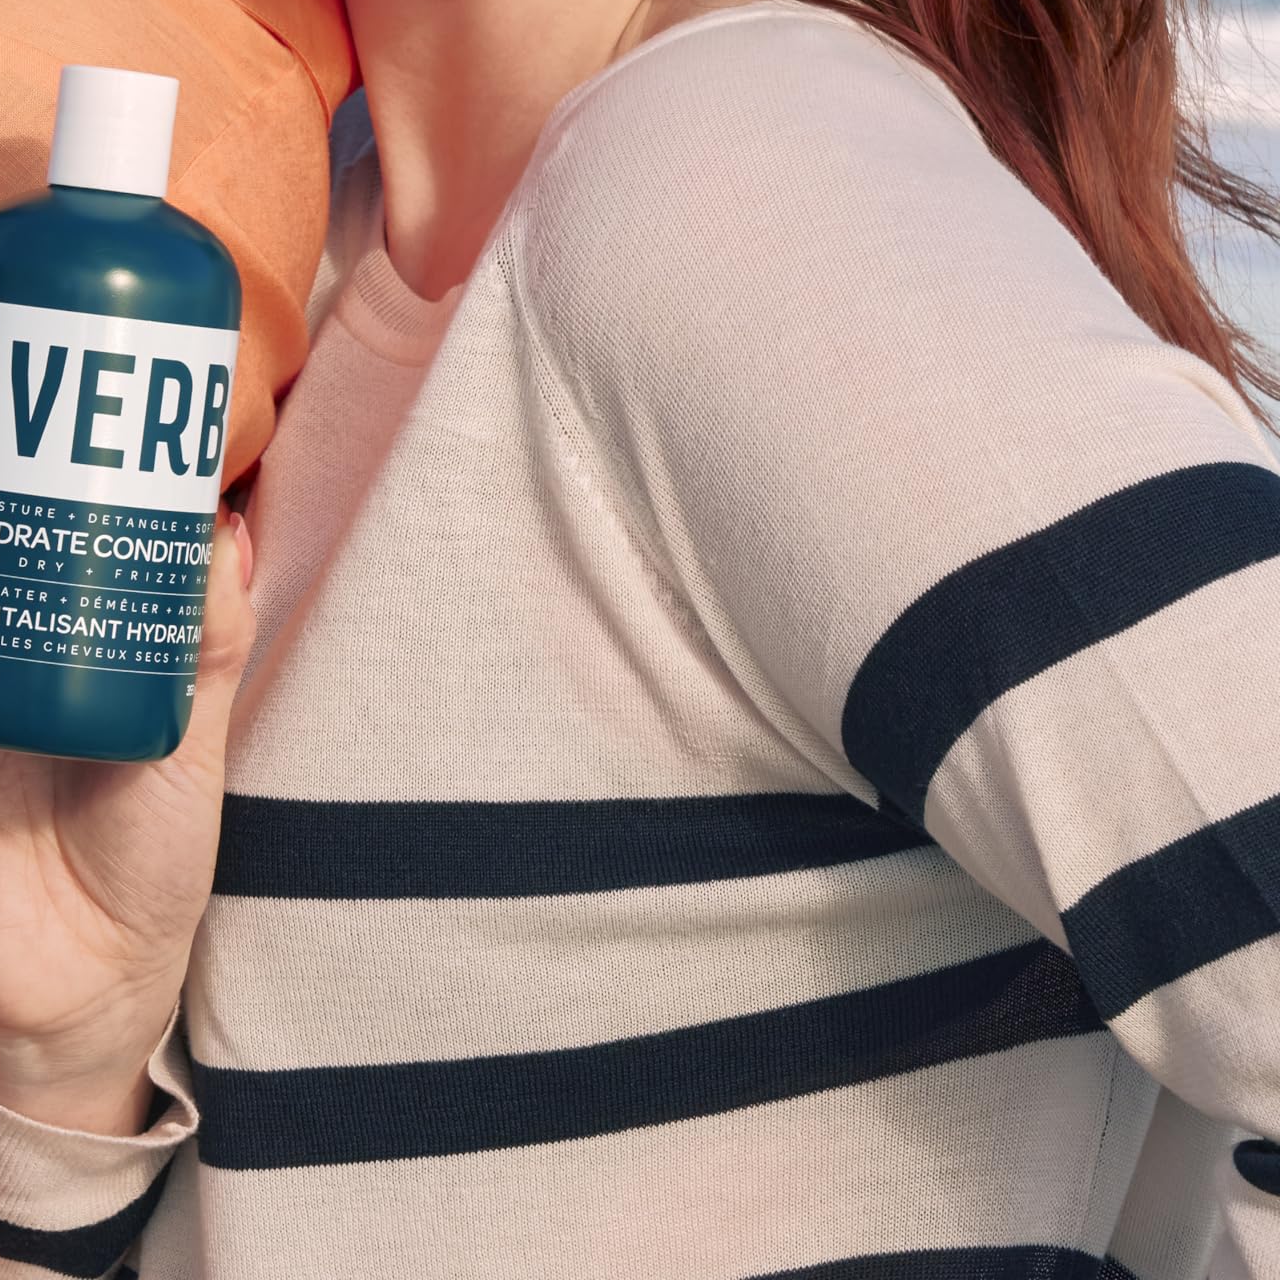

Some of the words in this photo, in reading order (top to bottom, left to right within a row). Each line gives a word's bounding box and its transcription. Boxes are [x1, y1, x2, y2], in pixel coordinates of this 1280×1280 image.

[11, 339, 229, 477] VERB
[87, 512, 177, 532] DETANGLE
[93, 534, 213, 566] CONDITIONE
[18, 557, 65, 573] DRY
[114, 568, 188, 585] FRIZZY
[80, 592, 159, 615] DÉMÊLER
[126, 622, 204, 645] HYDRATAN
[0, 635, 32, 650] LES
[43, 641, 128, 661] CHEVEUX
[135, 650, 169, 664] SECS
